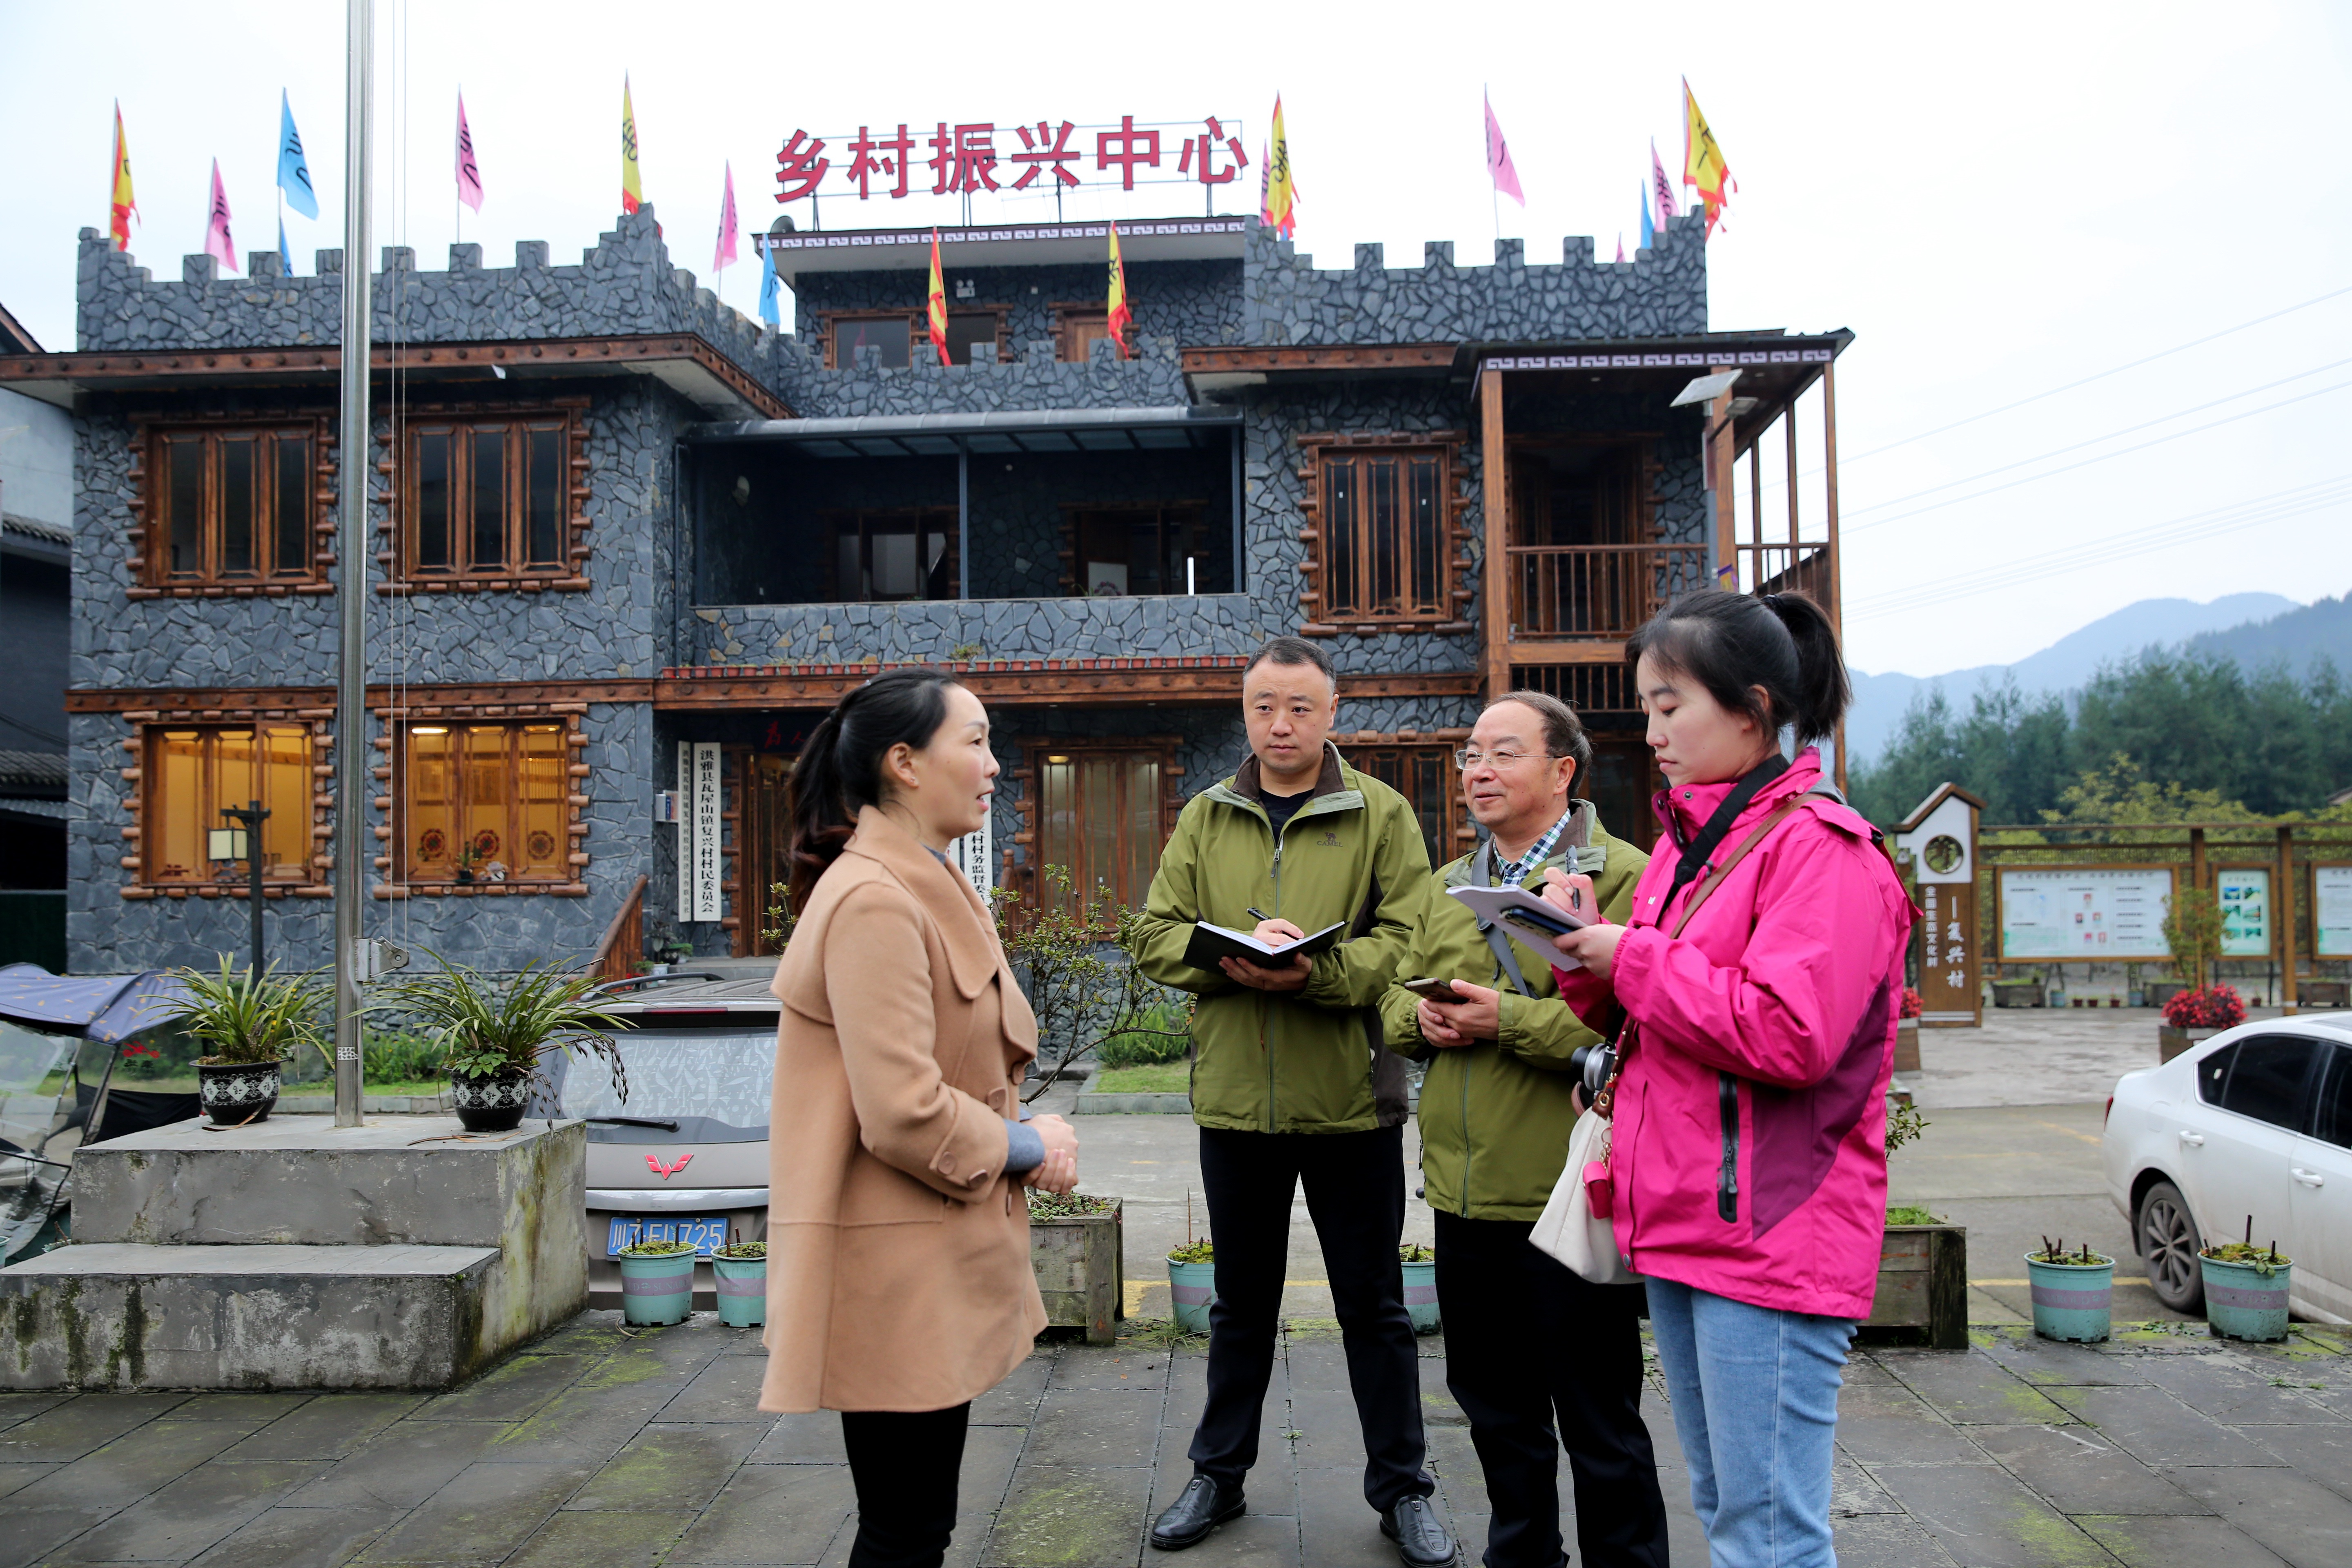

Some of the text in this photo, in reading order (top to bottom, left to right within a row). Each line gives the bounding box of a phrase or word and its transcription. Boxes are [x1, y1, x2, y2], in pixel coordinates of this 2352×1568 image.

[775, 115, 1249, 203] 乡村振兴中心
[700, 750, 715, 913] 洪雅县瓦屋山镇复兴村村民委员会
[971, 829, 985, 901] 村村务监督委
[1925, 886, 1938, 968] 全国生态文化村
